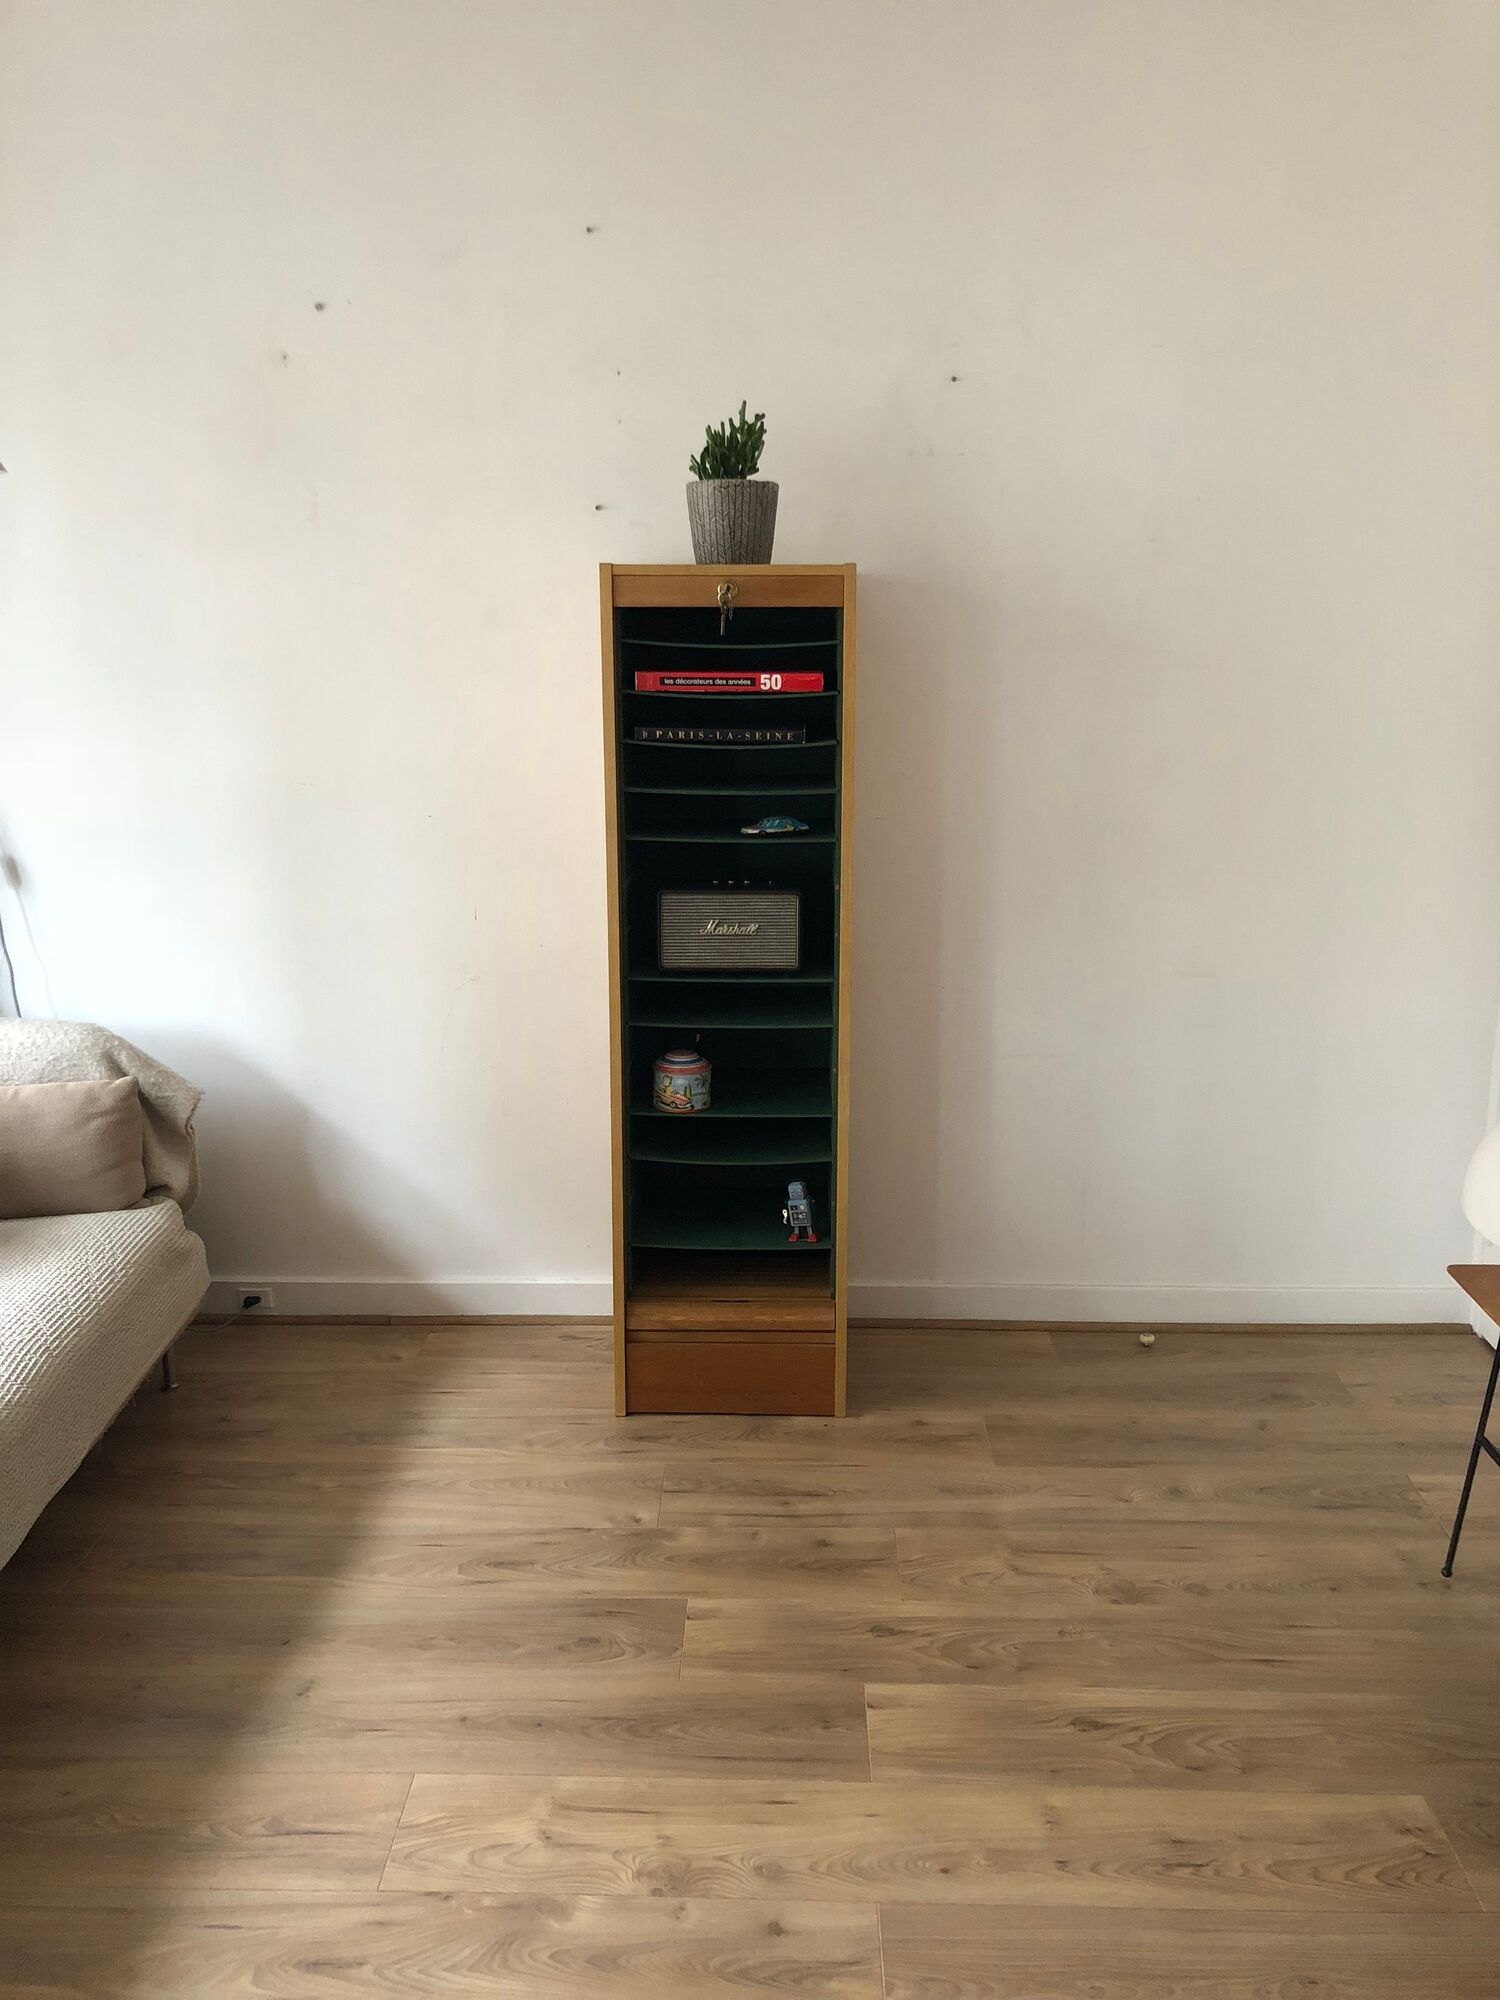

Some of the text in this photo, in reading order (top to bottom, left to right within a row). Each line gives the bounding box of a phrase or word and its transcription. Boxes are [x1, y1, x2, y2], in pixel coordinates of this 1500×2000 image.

[664, 674, 782, 691] les décorateurs des années 50
[700, 919, 759, 936] Marshall
